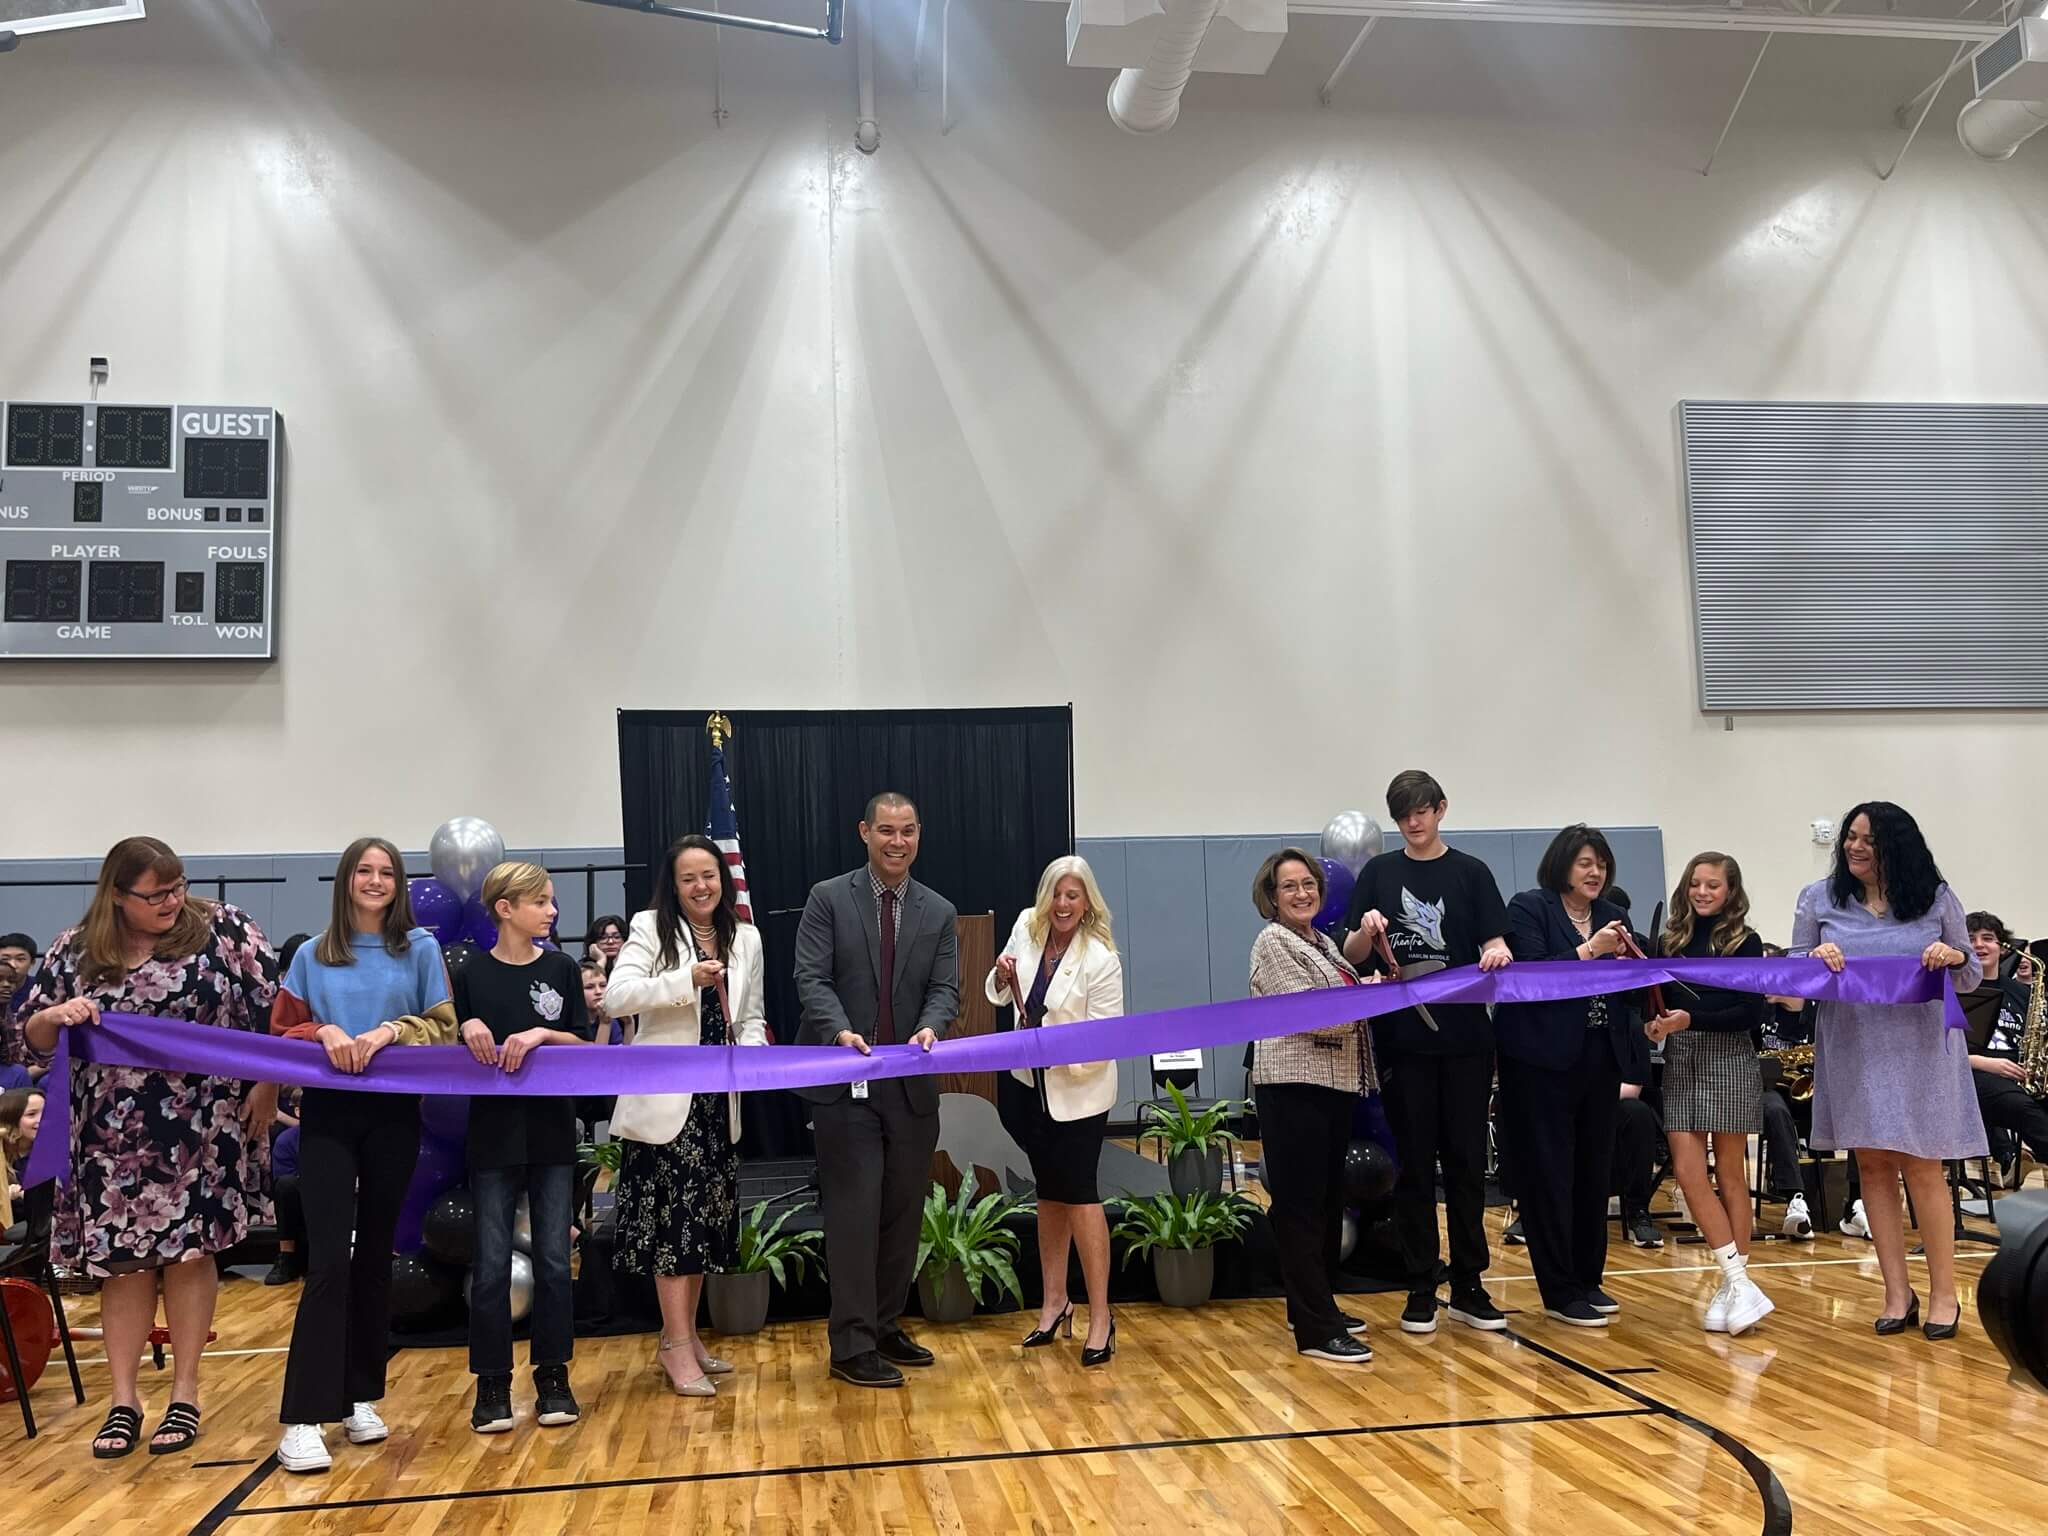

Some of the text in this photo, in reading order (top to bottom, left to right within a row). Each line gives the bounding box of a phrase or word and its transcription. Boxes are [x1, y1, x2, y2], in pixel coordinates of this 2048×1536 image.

[182, 412, 270, 436] GUEST
[62, 471, 116, 482] PERIOD
[0, 506, 30, 519] NUS
[147, 508, 202, 521] BONUS
[51, 545, 121, 558] PLAYER
[207, 546, 268, 560] FOULS
[170, 615, 208, 626] T.O.L.
[56, 626, 112, 639] GAME
[215, 626, 264, 639] WON
[1388, 932, 1424, 951] Theatre
